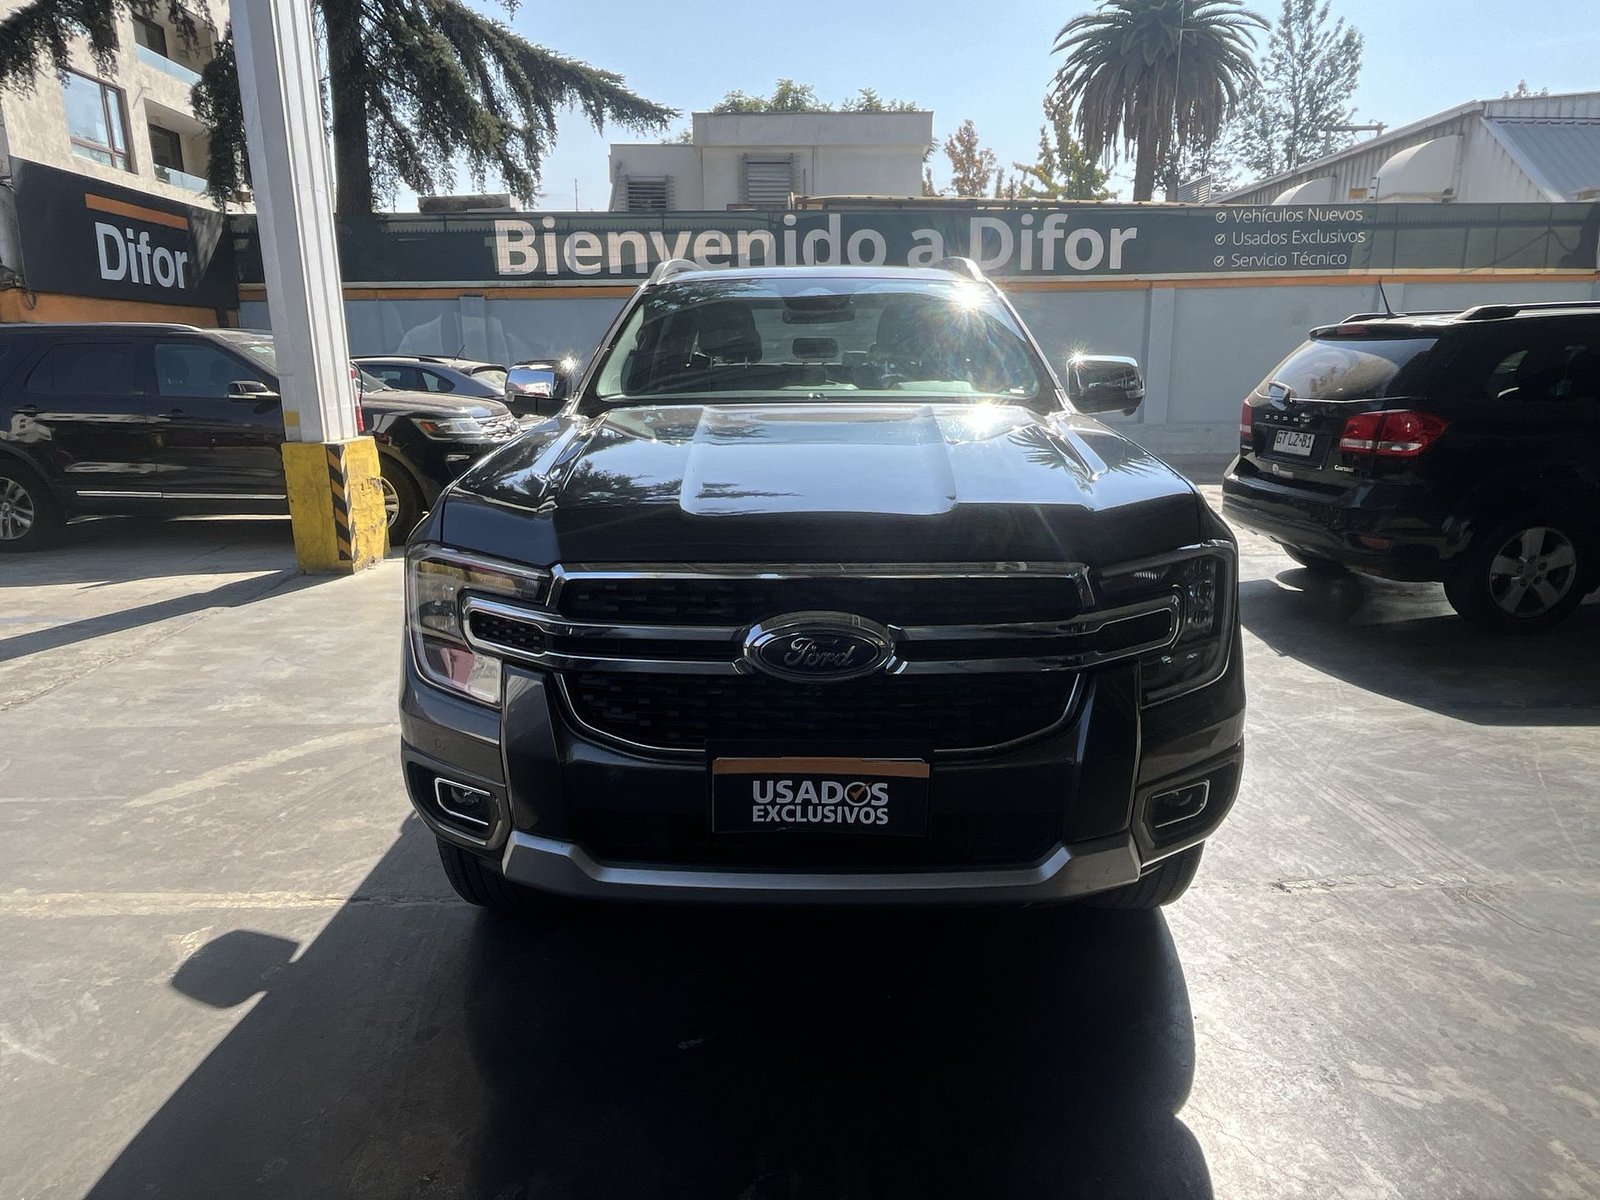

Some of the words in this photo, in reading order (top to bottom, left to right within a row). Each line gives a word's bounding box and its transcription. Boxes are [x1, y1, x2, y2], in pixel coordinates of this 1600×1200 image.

[1232, 207, 1304, 223] Vehículos
[1307, 207, 1364, 222] Nuevos
[494, 213, 888, 275] Bienvenido
[906, 228, 944, 268] a
[969, 213, 1138, 271] Difor
[1232, 230, 1288, 246] Usados
[1292, 229, 1366, 244] Exclusivos
[94, 221, 188, 289] Difor
[1231, 252, 1287, 268] Servicio
[1291, 251, 1348, 266] Técnico
[783, 637, 856, 667] Ford
[752, 780, 889, 806] USADOS
[752, 805, 889, 825] EXCLUSIVOS
